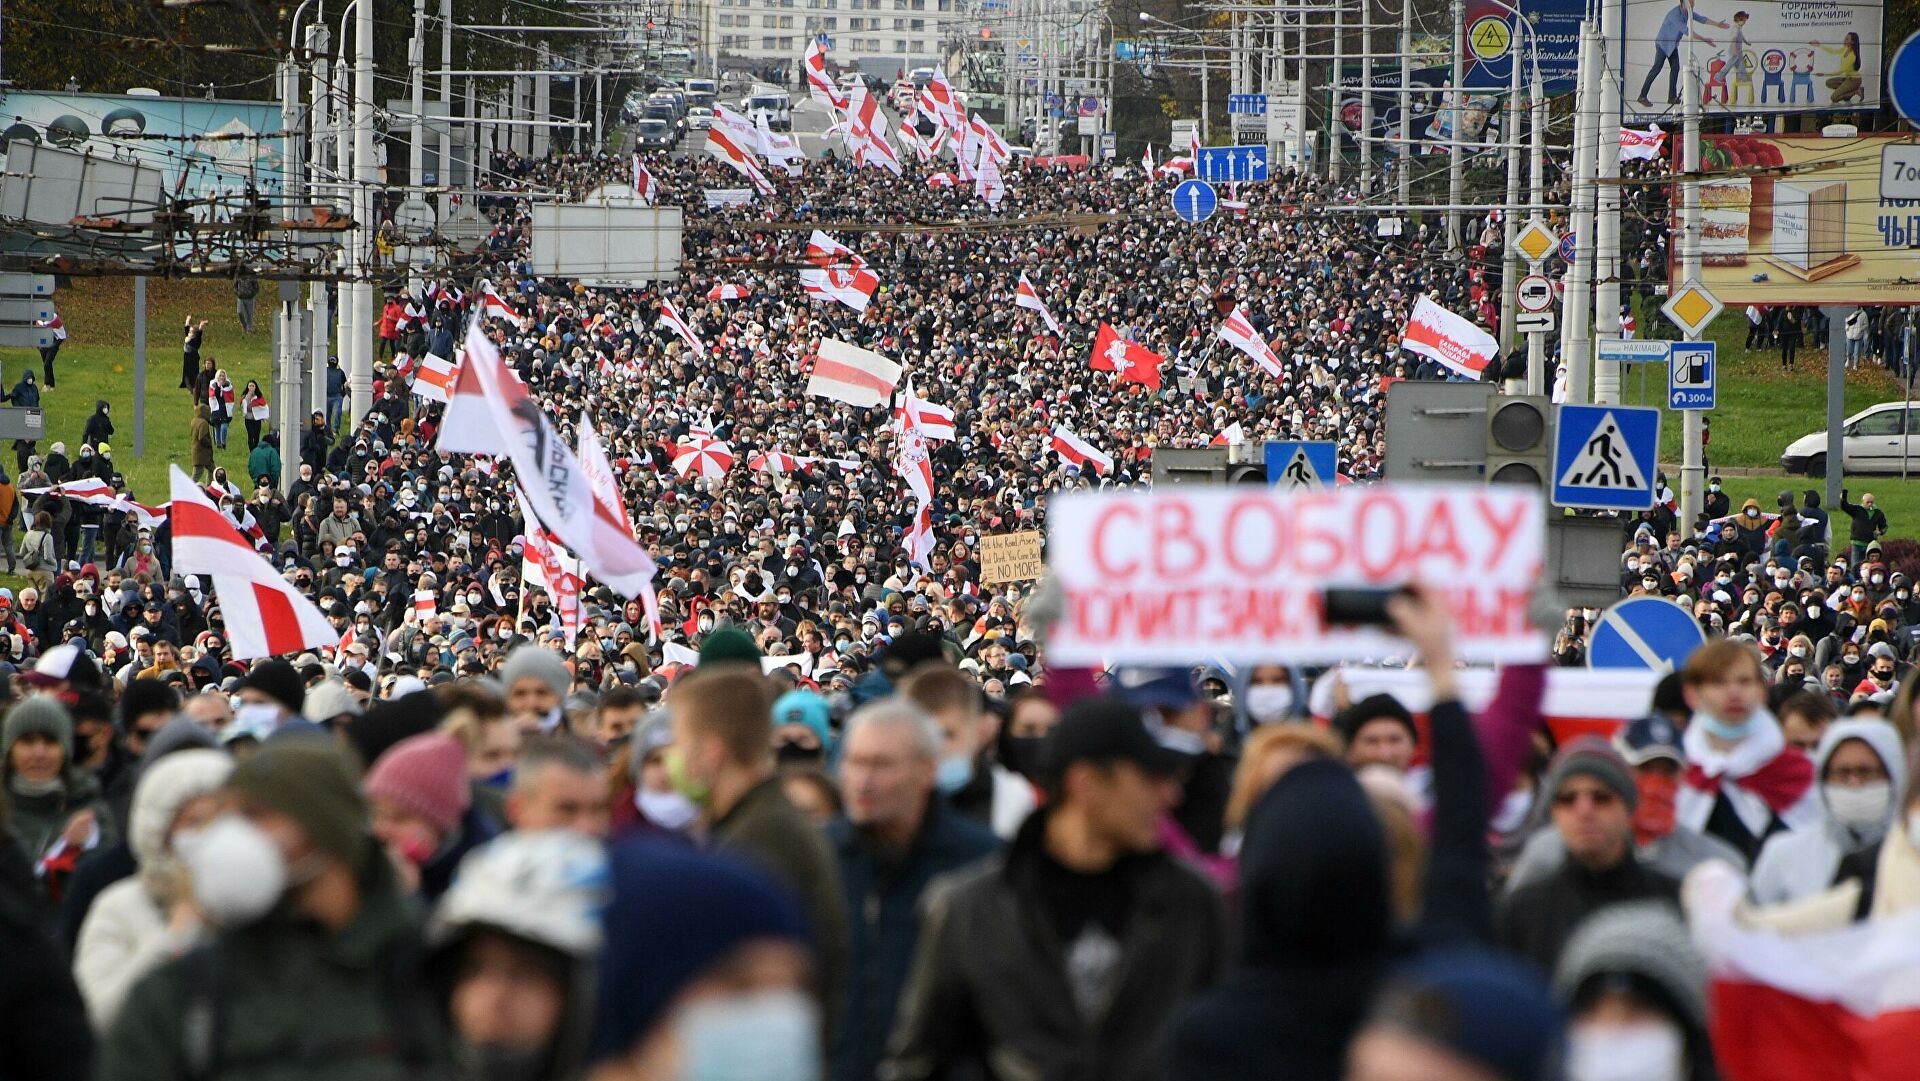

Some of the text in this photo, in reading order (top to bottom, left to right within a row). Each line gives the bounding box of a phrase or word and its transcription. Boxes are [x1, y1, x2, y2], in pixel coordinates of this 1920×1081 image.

[1781, 10, 1853, 19] ЧТО НАУЧИЛИ!
[1623, 344, 1662, 353] НАХІМАВА
[1688, 393, 1706, 403] 300
[1089, 493, 1530, 582] СВОБОДУ
[997, 560, 1041, 579] NO MORE
